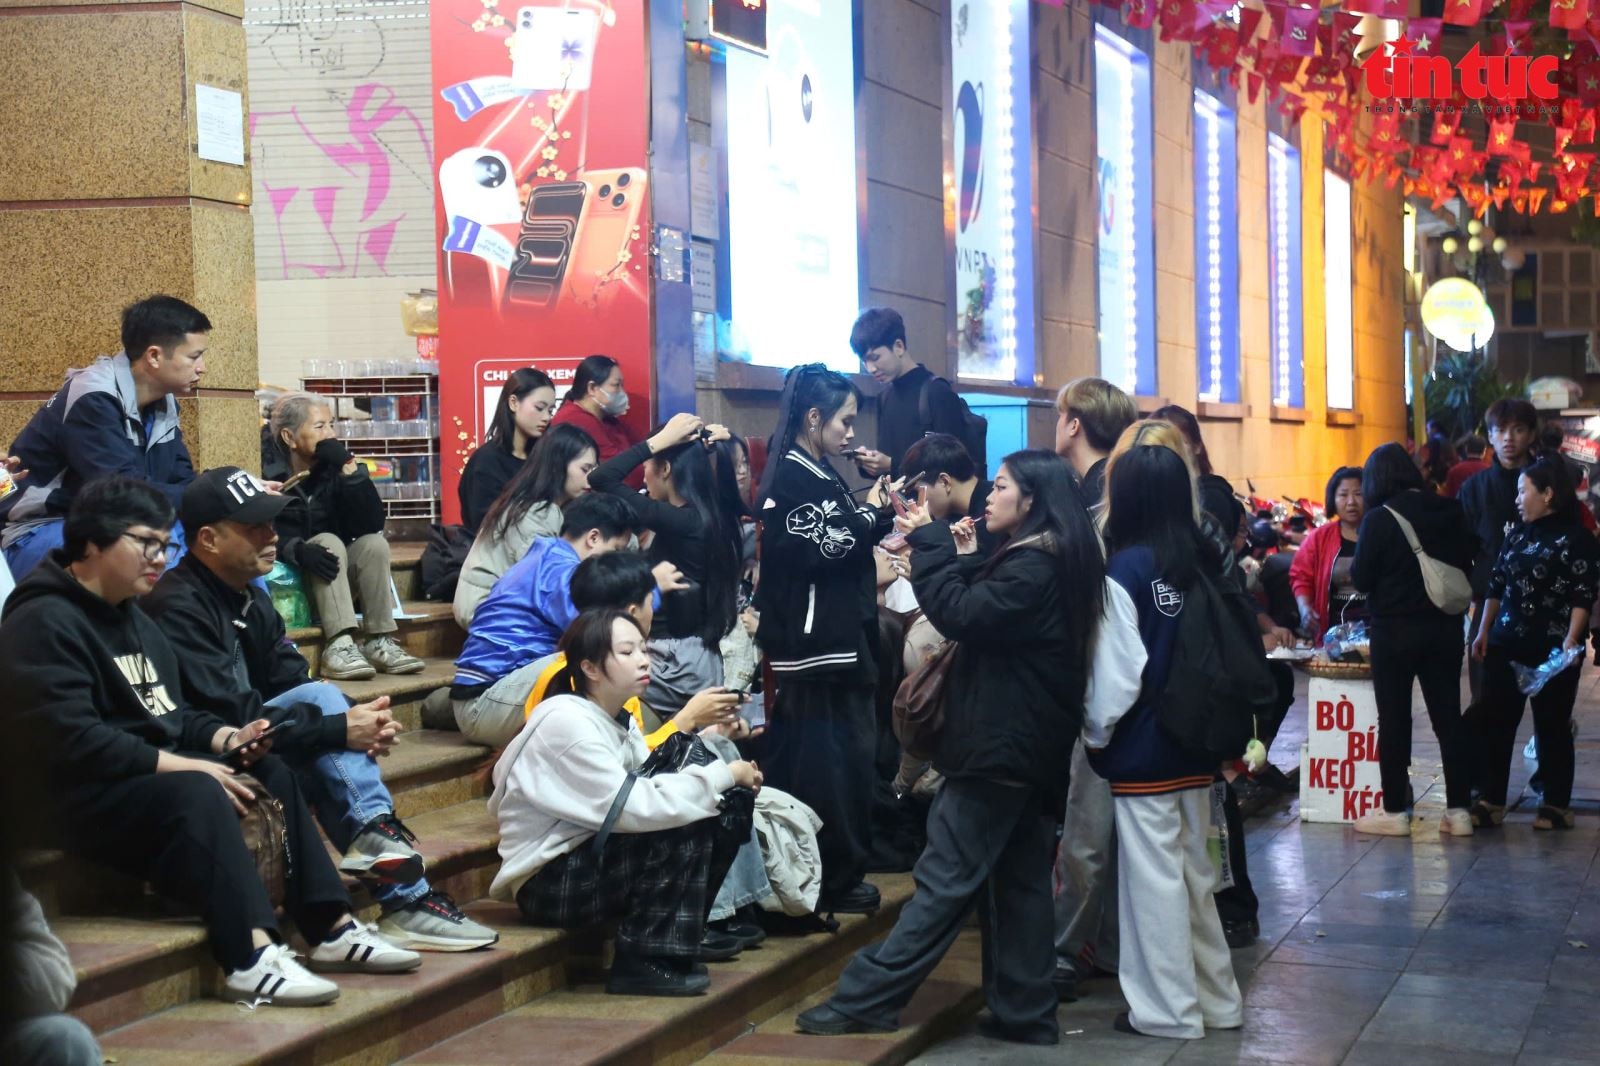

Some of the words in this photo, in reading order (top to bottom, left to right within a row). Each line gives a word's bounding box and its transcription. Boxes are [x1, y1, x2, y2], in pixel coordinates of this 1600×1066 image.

[483, 370, 509, 381] CHI
[1316, 694, 1355, 731] BÒ
[1308, 757, 1355, 795] KẸO
